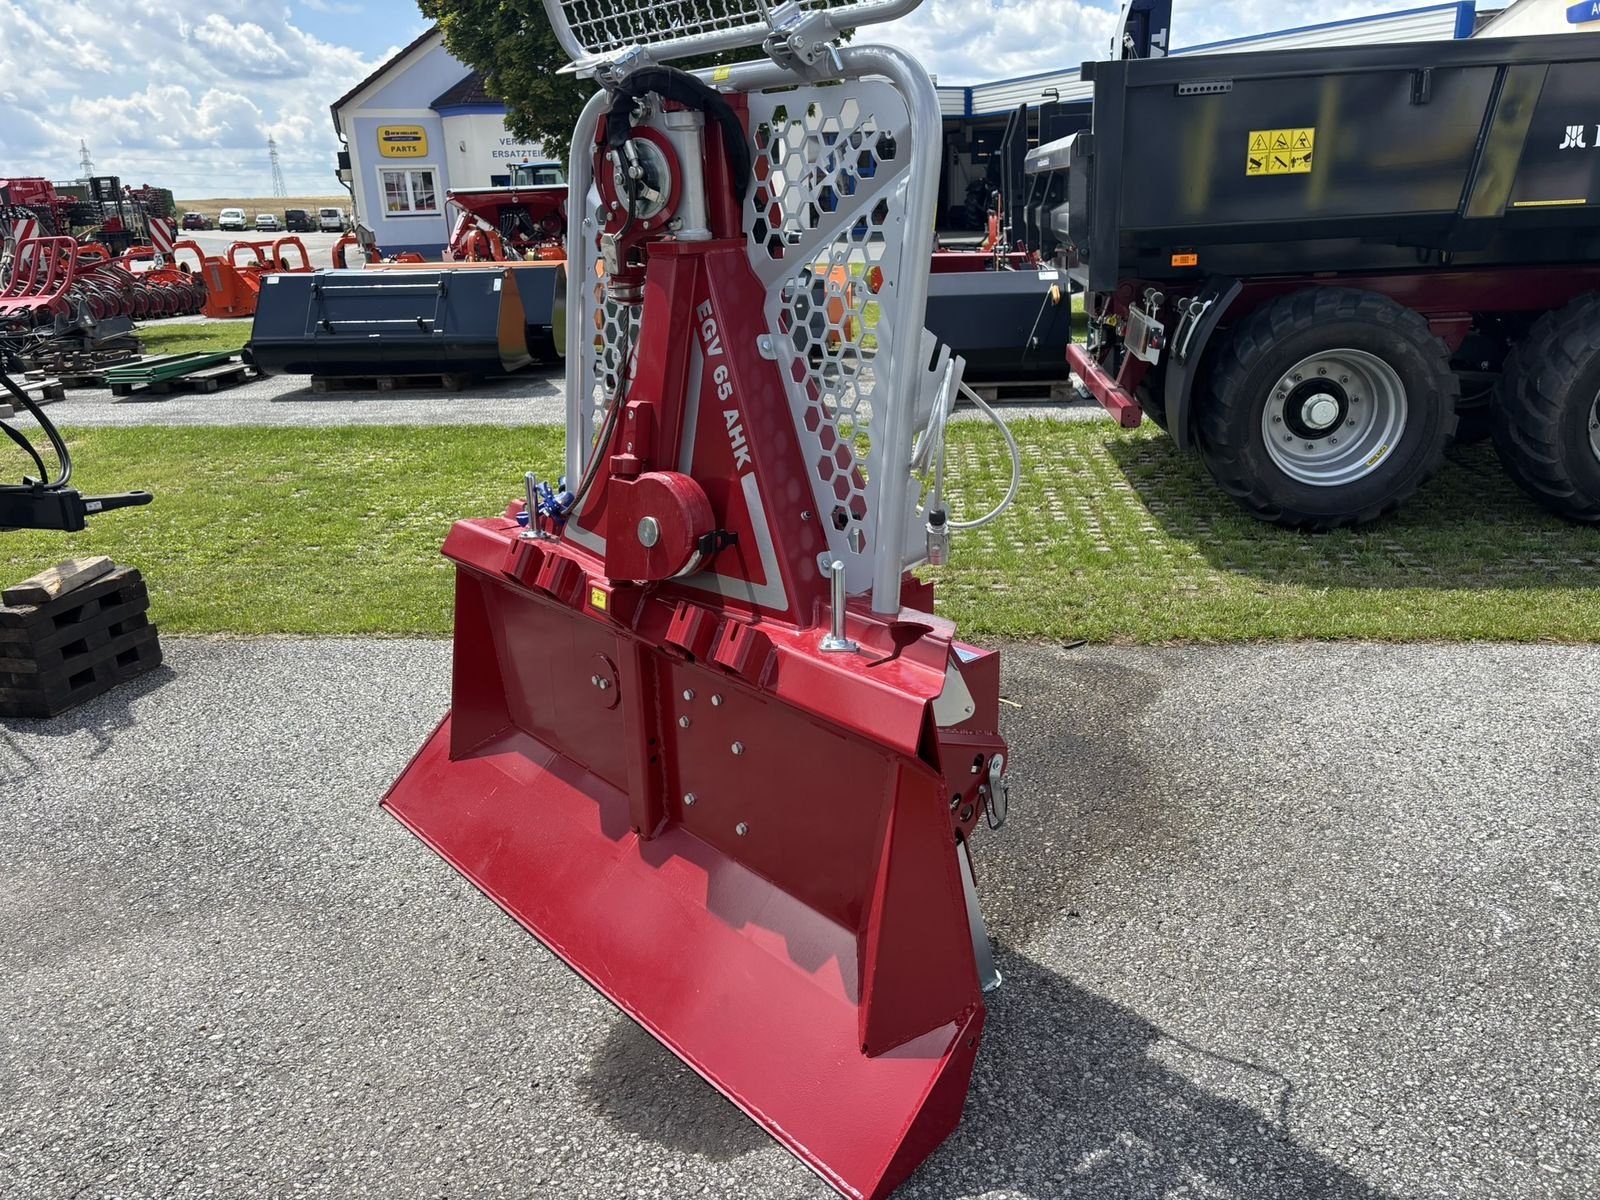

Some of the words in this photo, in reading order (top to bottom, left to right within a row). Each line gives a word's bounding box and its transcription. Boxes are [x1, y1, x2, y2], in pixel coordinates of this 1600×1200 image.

[390, 145, 417, 153] PARTS
[696, 298, 723, 357] EGV
[713, 364, 735, 401] 65
[723, 408, 752, 471] AHK
